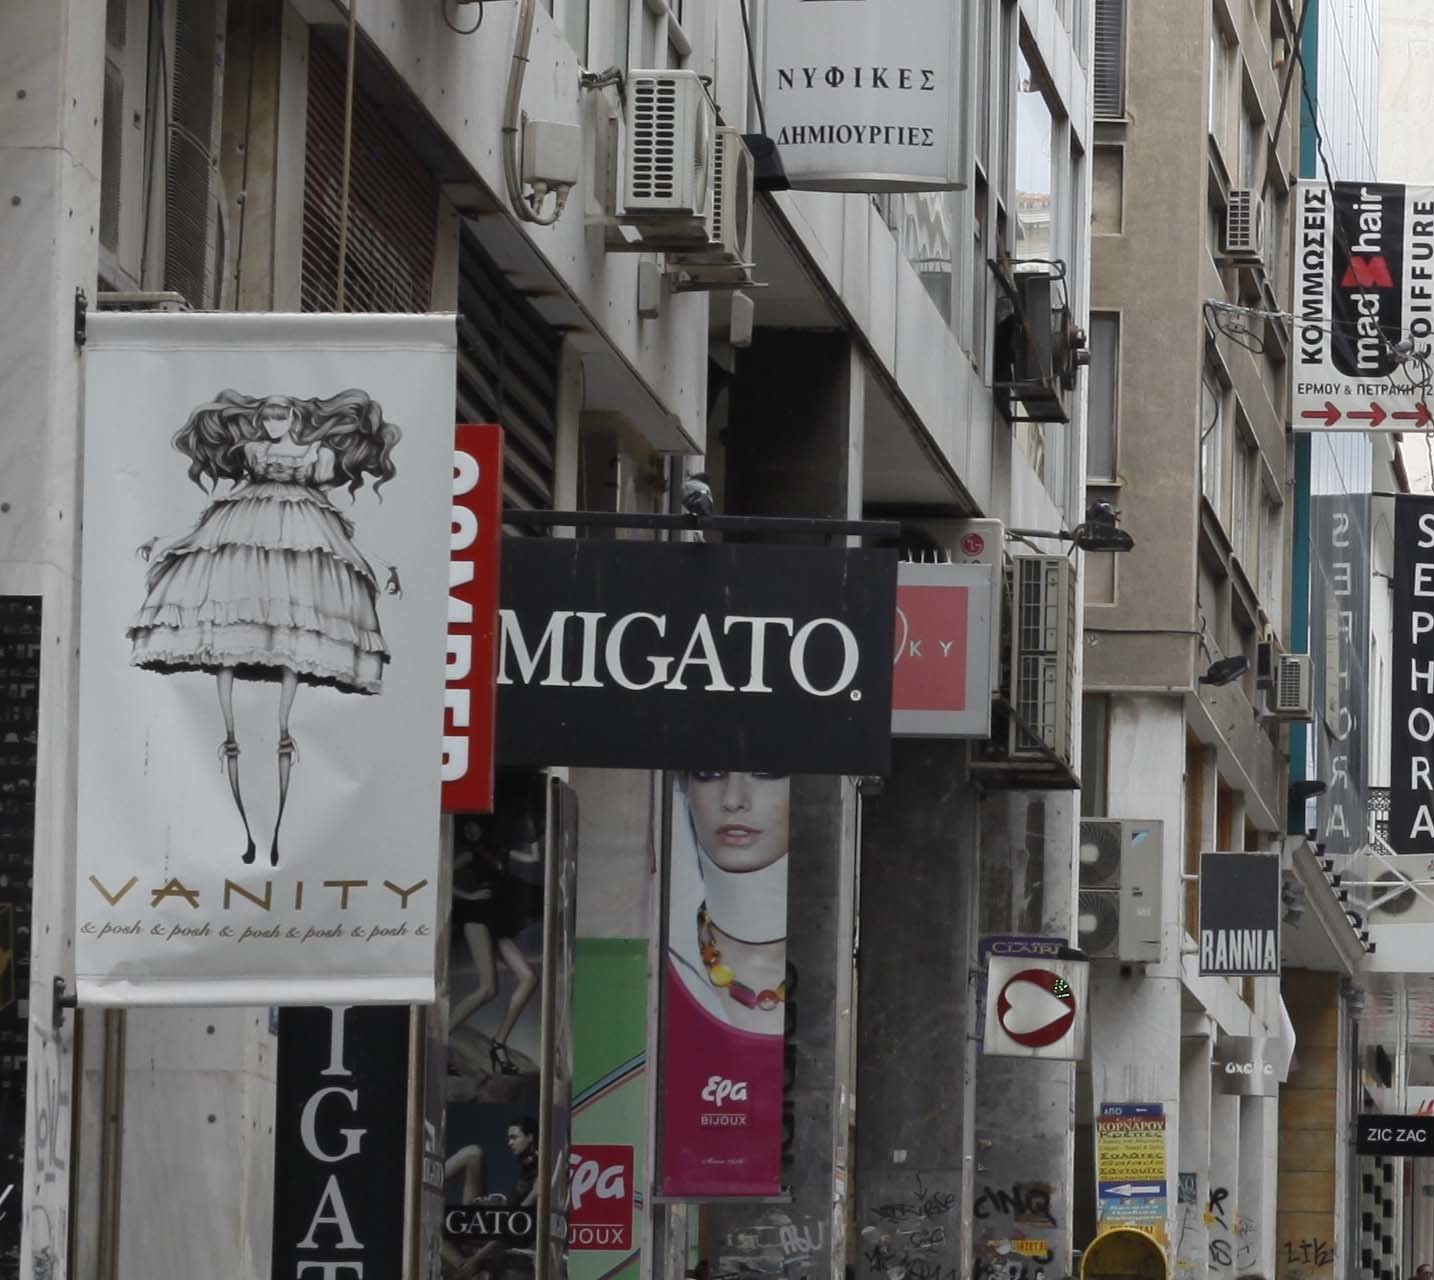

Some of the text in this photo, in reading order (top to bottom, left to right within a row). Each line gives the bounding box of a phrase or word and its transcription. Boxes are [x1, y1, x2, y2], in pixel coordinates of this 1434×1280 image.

[777, 66, 935, 91] ΝΥΦΙΚΕΣ
[776, 124, 934, 147] ΔΗΜΙΟΥΡΓΙΕΣ
[1350, 186, 1383, 253] hair
[1301, 188, 1326, 365] ΚΟΜΜΩΣΕΙΣ
[1298, 383, 1341, 395] ΕΡΜΟΥ
[496, 609, 859, 697] MIGATO
[89, 875, 428, 911] VANITY
[97, 918, 142, 939] posh
[168, 920, 210, 942] posh
[238, 923, 281, 943] posh
[300, 920, 344, 943] posh
[366, 920, 408, 941] posh
[701, 1115, 746, 1125] BIJOUX
[1099, 1121, 1164, 1131] ΚΟΡΝΑΡΟΥ
[1368, 1129, 1427, 1142] ZIC ZAC
[568, 1228, 624, 1244] JOUX
